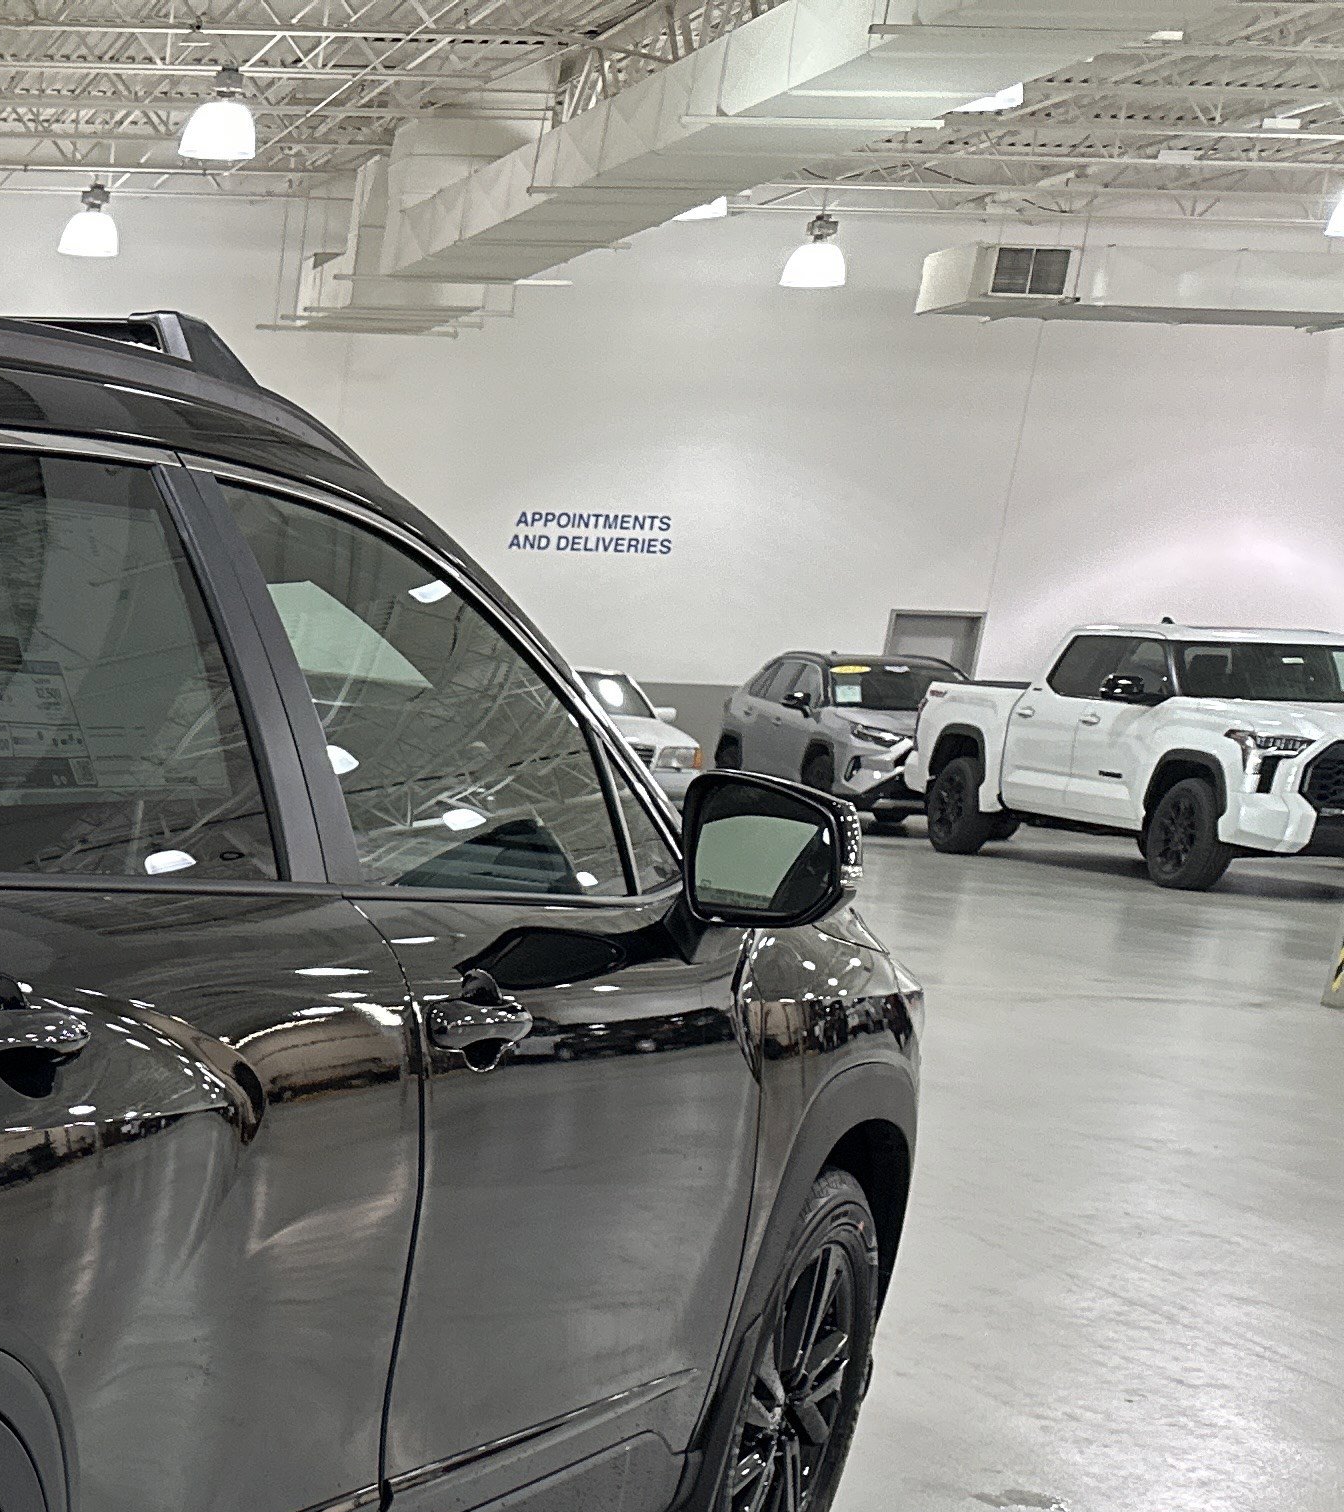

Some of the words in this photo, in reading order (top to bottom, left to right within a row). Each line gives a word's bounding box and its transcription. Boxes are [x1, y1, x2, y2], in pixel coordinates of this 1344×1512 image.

[516, 511, 672, 532] APPOINTMENTS
[508, 534, 551, 551] AND
[556, 535, 672, 555] DELIVERIES
